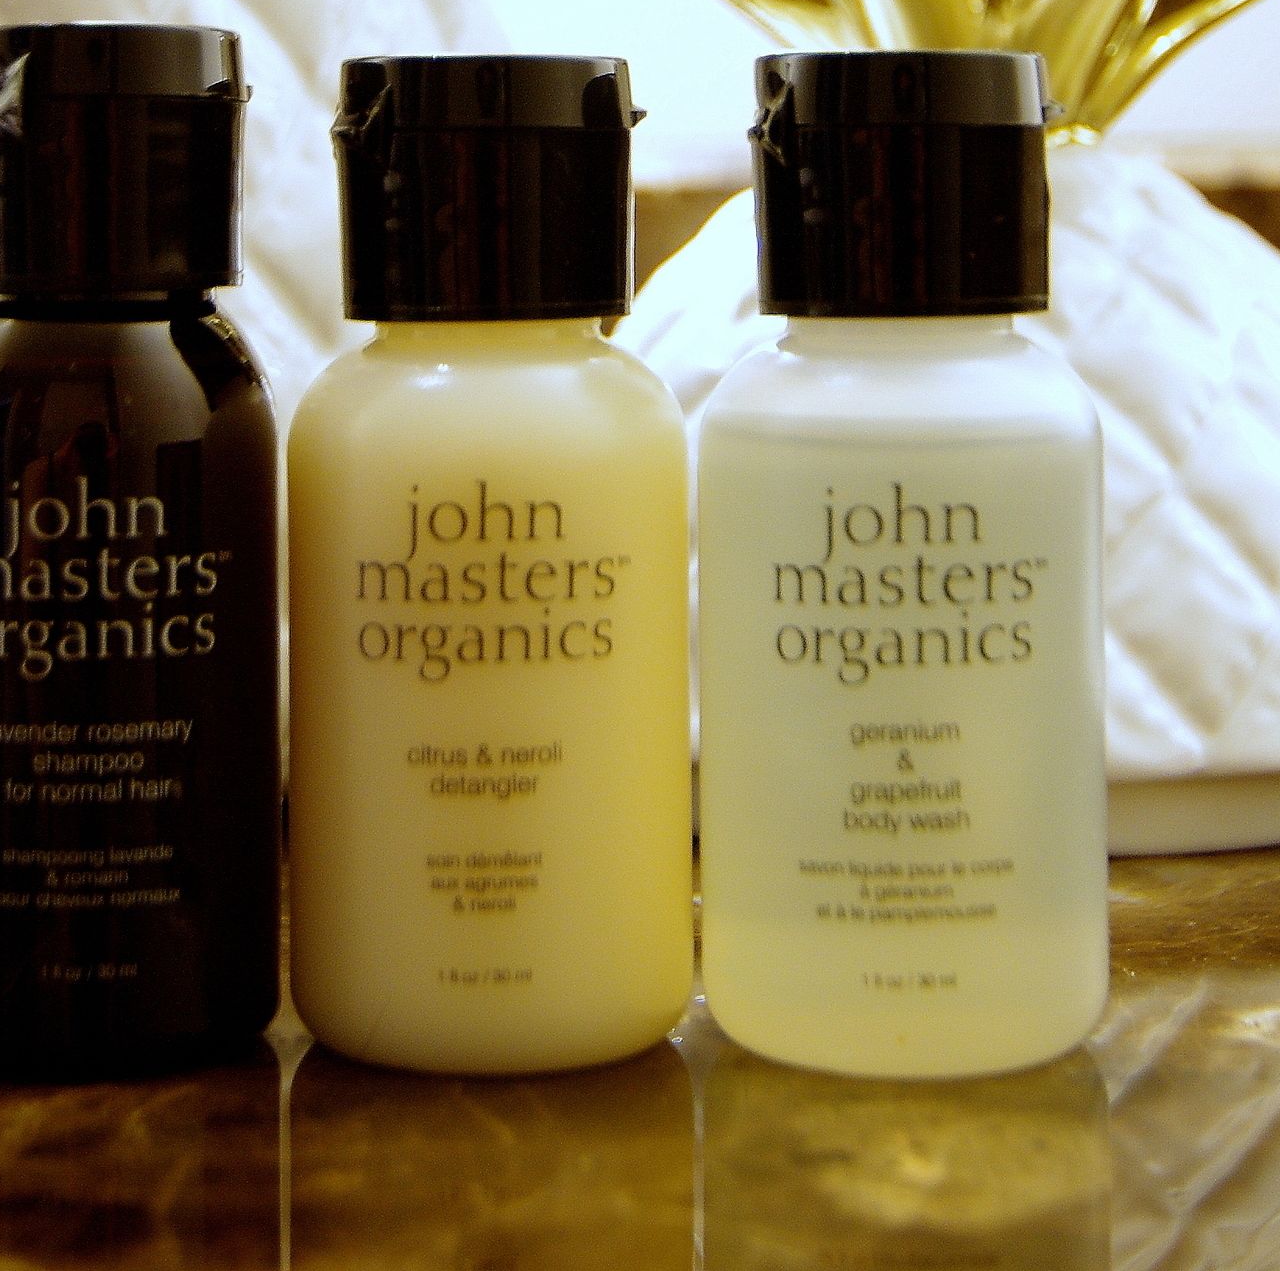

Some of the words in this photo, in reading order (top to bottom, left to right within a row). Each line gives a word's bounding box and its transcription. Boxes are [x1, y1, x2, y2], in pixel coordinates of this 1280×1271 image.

[4, 475, 168, 557] john
[406, 479, 565, 562] john
[824, 482, 981, 563] john
[359, 607, 614, 683] organics
[777, 610, 1033, 684] organics
[87, 719, 194, 744] rosemary
[850, 720, 961, 747] geranium
[33, 750, 145, 775] shampoo
[407, 743, 468, 766] citrus
[477, 742, 493, 766] &
[501, 740, 563, 765] neroli
[896, 748, 914, 772] &
[5, 778, 33, 802] for
[41, 779, 123, 802] normal
[130, 778, 173, 801] hair
[430, 773, 539, 801] detangler
[850, 779, 962, 805] grapefruit
[843, 808, 901, 835] body
[910, 808, 971, 831] wash
